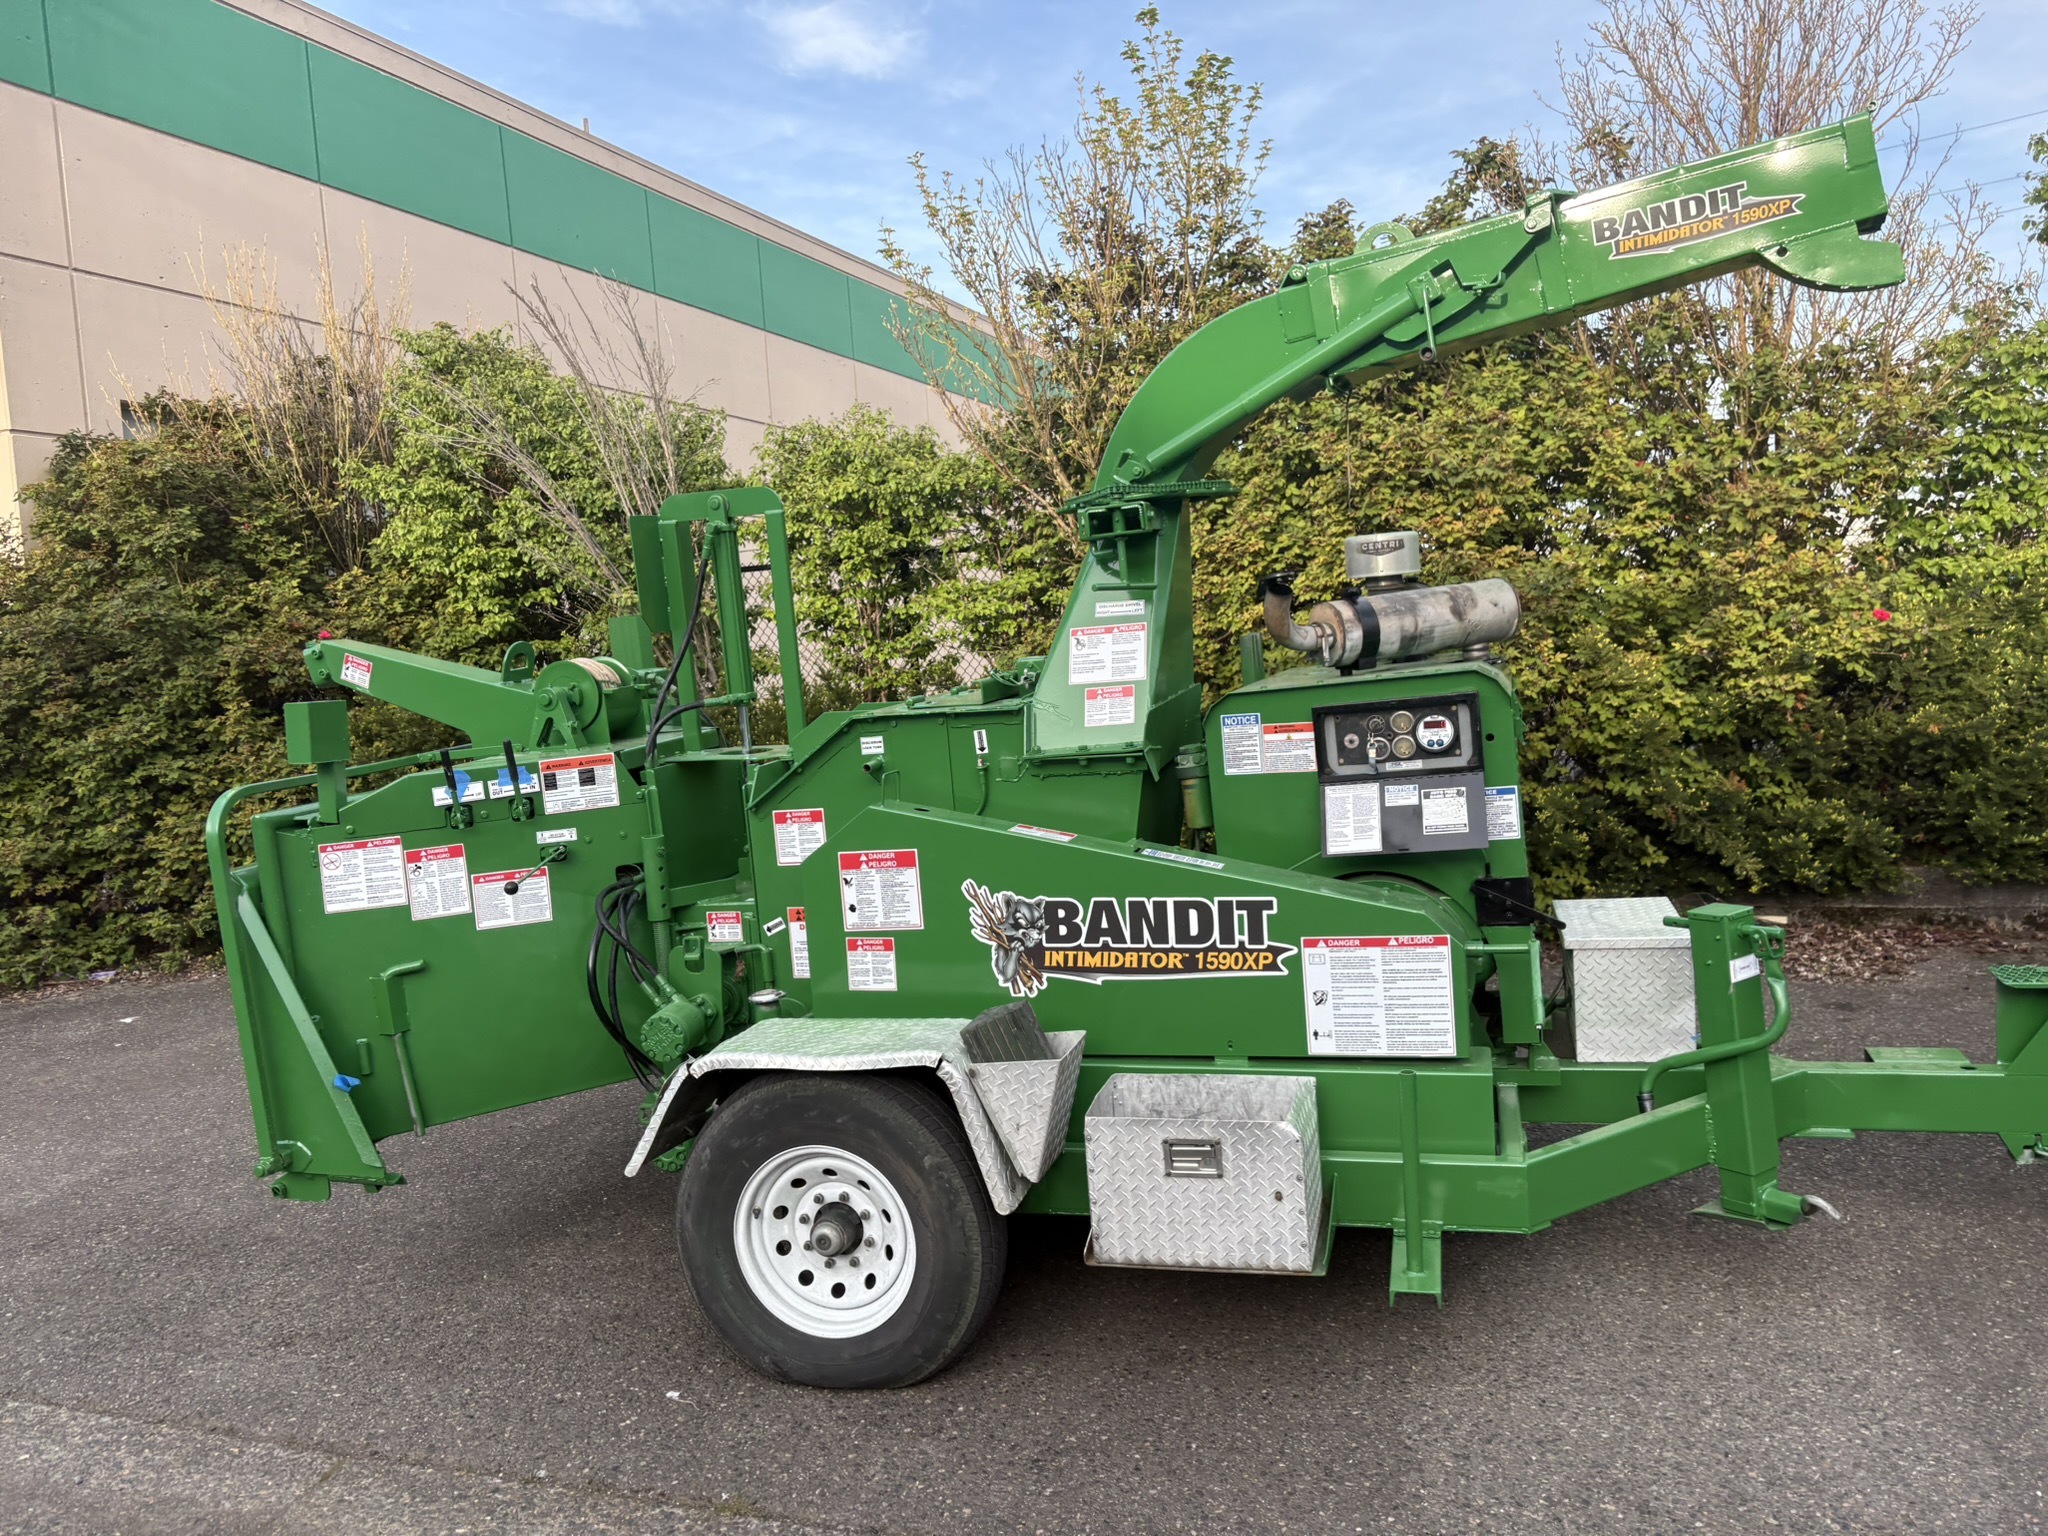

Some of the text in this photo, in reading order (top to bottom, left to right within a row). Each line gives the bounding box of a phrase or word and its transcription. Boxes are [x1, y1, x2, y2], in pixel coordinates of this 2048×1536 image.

[1594, 184, 1746, 243] BANDIT
[1732, 199, 1791, 226] 1590XP
[1362, 540, 1400, 551] CENTRI
[1119, 624, 1143, 632] PELIGRO
[1224, 716, 1257, 725] NOTICE
[373, 839, 396, 847] PELIGRO
[427, 847, 449, 855] DANGER
[427, 853, 451, 861] PELIGRO
[868, 852, 896, 860] DANGER
[868, 860, 898, 868] PELIGRO
[1044, 898, 1274, 948] BANDIT
[1398, 936, 1434, 945] PELIGRO
[1194, 953, 1274, 970] 1590XP
